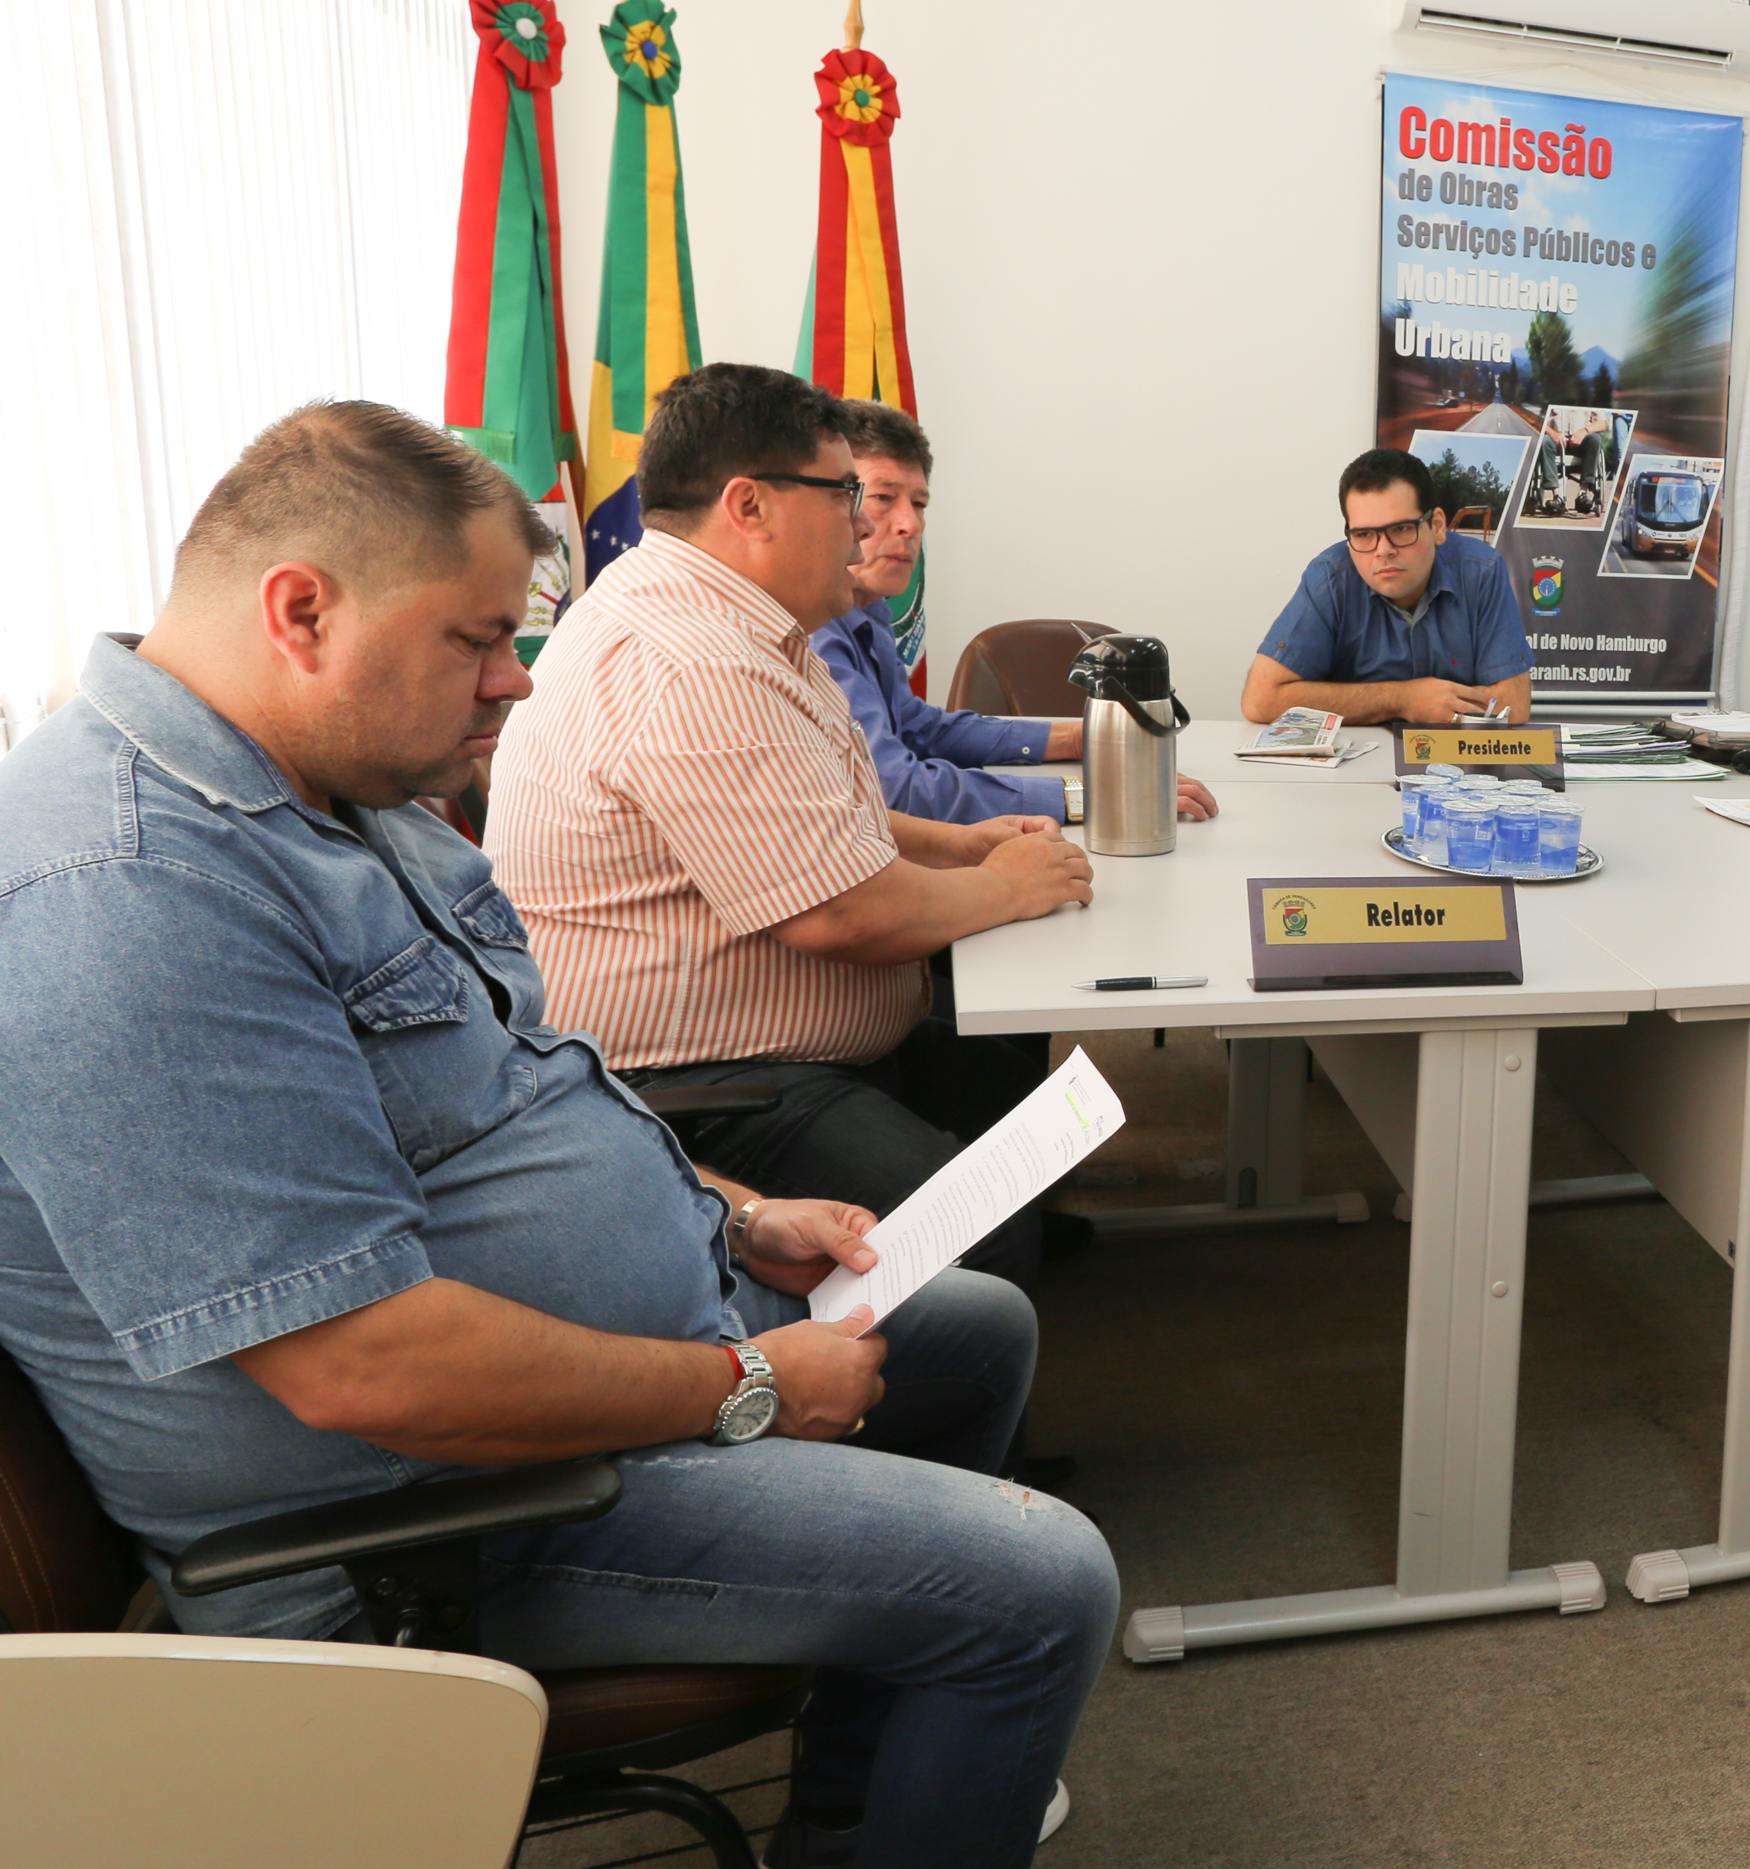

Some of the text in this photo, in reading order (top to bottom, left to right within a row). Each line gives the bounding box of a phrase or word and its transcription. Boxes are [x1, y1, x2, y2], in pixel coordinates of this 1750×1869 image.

[1399, 106, 1612, 179] Comissão
[1399, 168, 1519, 210] de Obras
[1397, 214, 1656, 270] Serviços Públicos e
[1396, 262, 1577, 315] Mobilidade
[1394, 318, 1512, 363] Urbana
[1540, 633, 1557, 650] de
[1560, 633, 1594, 651] Novo
[1596, 634, 1667, 654] Hamburgo
[1458, 739, 1531, 755] Presidente
[1366, 902, 1446, 927] Relator
